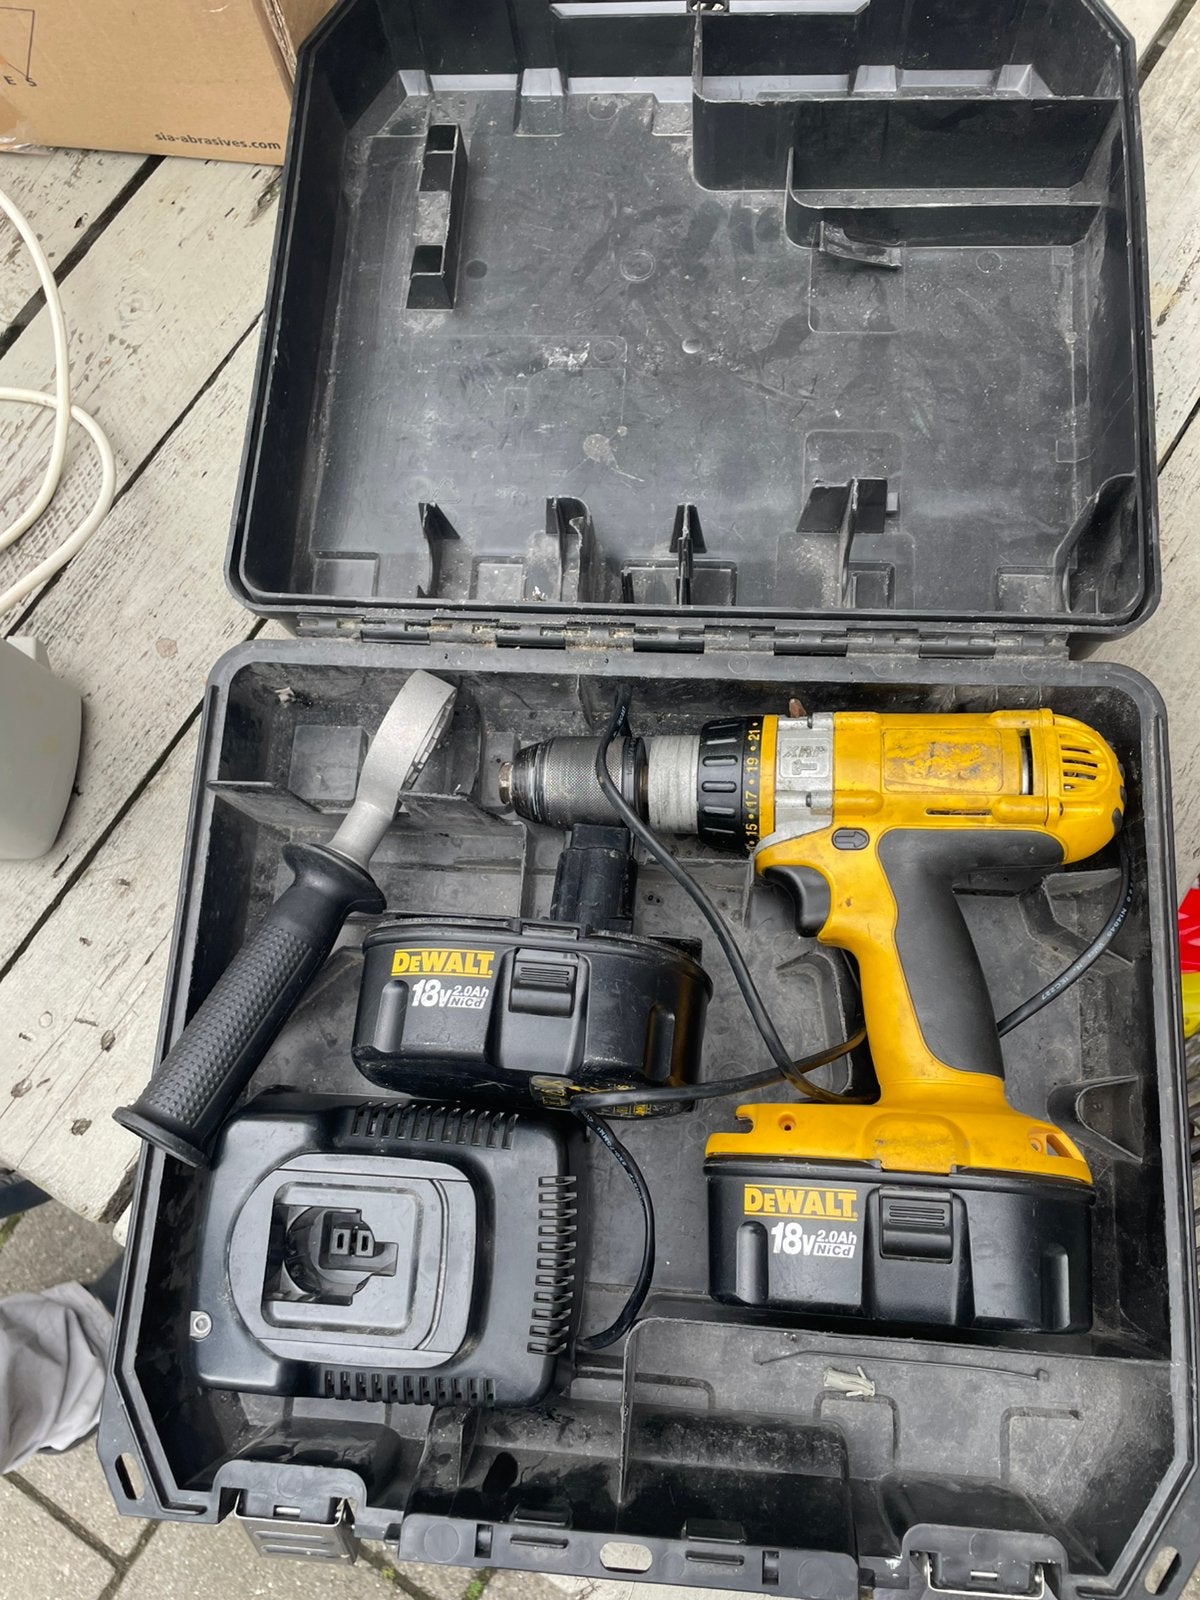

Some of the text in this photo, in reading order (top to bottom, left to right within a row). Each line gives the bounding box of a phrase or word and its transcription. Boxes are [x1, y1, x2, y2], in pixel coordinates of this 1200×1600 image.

[154, 131, 282, 150] sia-abrasives.com
[745, 729, 760, 836] 15 17 19 21
[452, 985, 490, 998] 2.0Ah
[450, 997, 482, 1009] NiCd
[816, 1229, 858, 1245] 2.0Ah
[816, 1244, 851, 1257] NiCd
